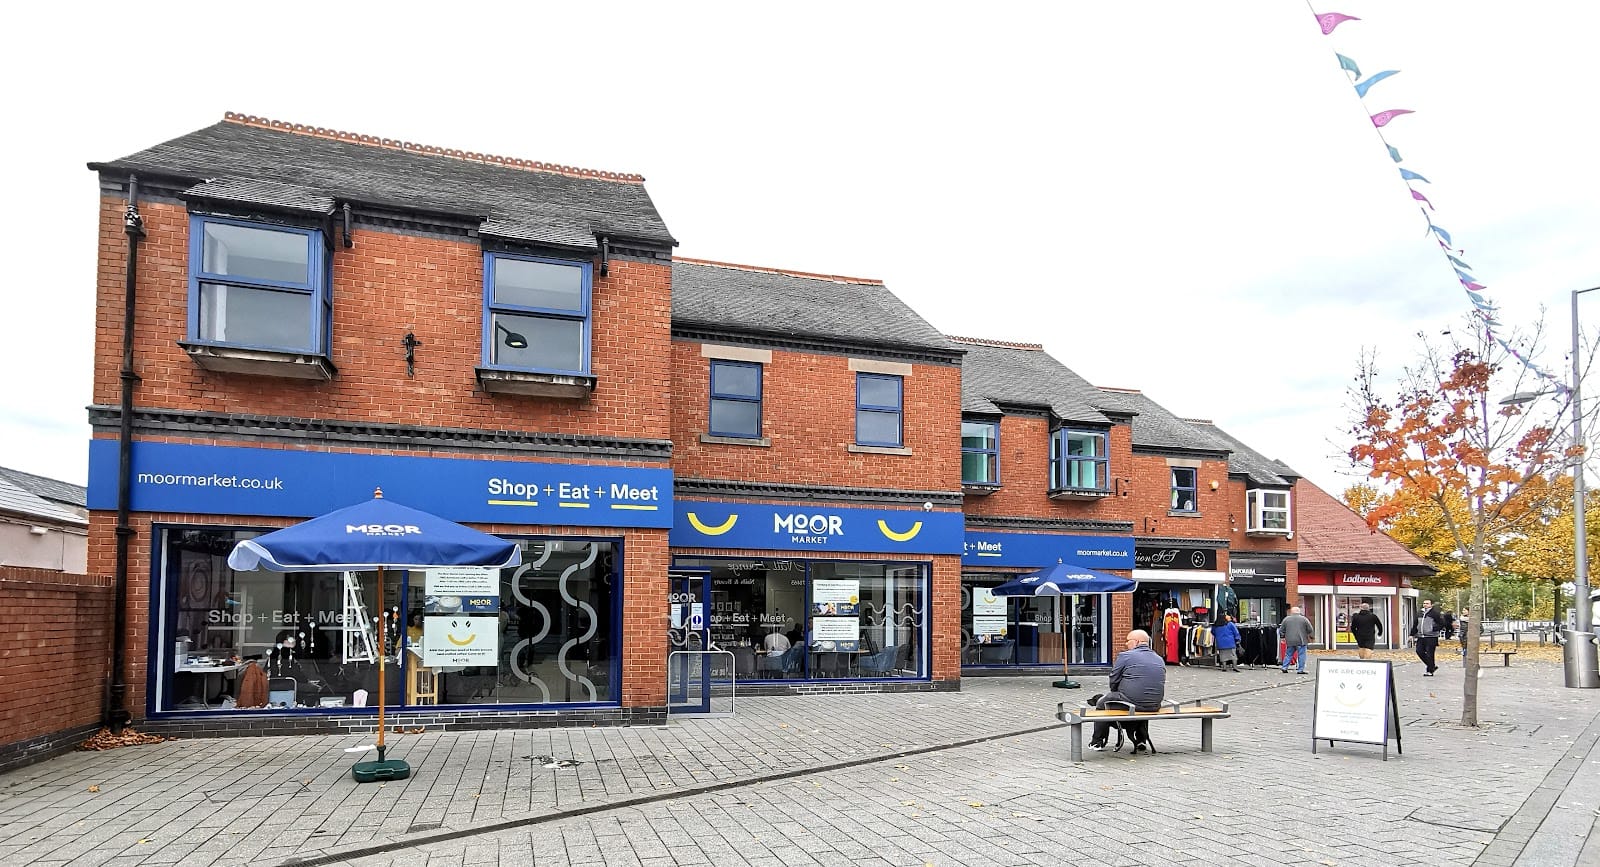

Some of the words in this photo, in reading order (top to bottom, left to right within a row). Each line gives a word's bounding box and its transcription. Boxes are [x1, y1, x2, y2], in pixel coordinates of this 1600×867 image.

[138, 473, 283, 490] moormarket.co.uk
[487, 478, 538, 500] Shop
[559, 482, 590, 500] Eat
[611, 483, 658, 501] Meet
[346, 524, 422, 534] MOOR
[774, 512, 844, 536] MOOR
[791, 535, 828, 544] MARKET
[977, 541, 1002, 551] Meet
[1076, 549, 1128, 557] moormarket.co.uk
[1342, 574, 1382, 583] Ladbrokes
[208, 610, 253, 626] Shop
[272, 610, 301, 623] Eat
[733, 613, 749, 622] Eat
[760, 613, 785, 622] Meet
